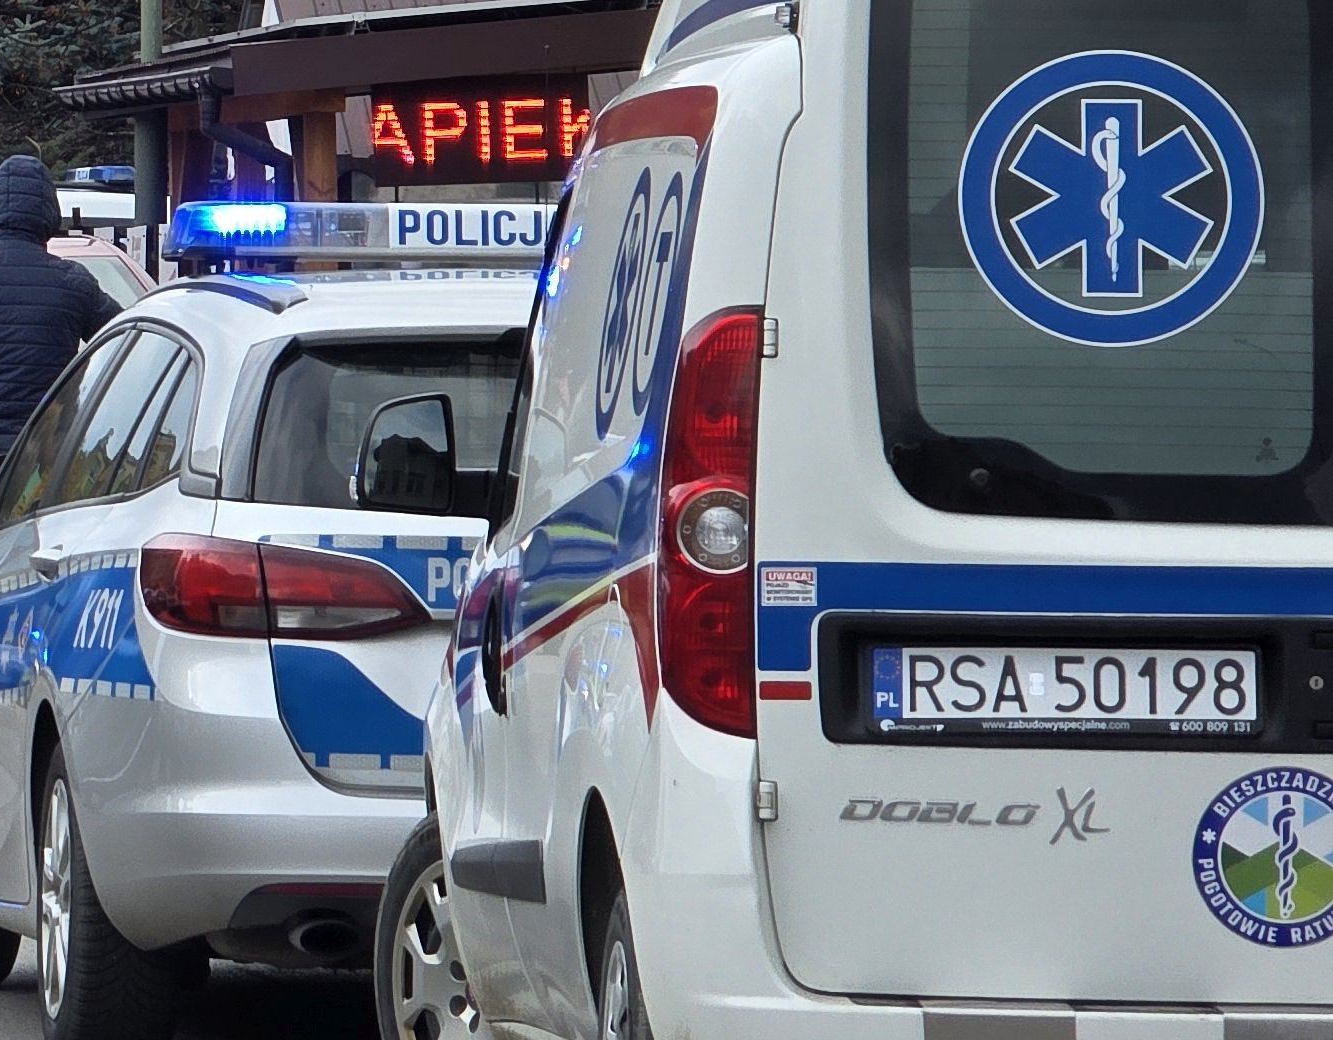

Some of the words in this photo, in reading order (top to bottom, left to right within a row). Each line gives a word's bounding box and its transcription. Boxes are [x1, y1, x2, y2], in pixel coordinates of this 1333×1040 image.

[398, 209, 556, 247] POLICJ
[768, 572, 812, 581] UWAGA!
[73, 588, 125, 650] K911
[876, 692, 899, 708] PL
[908, 654, 1028, 713] RSA
[1054, 655, 1247, 715] 50198
[981, 720, 1130, 731] www.zabudowyspecjalne.com
[1182, 722, 1203, 731] 600
[1207, 722, 1228, 732] 809
[1234, 722, 1251, 733] 131
[840, 799, 1041, 826] DOBLO
[1049, 785, 1111, 845] XL
[1213, 771, 1333, 818] BIESZCZADZ
[1198, 858, 1278, 943] POGOTOWIE
[1291, 911, 1333, 943] RATU
